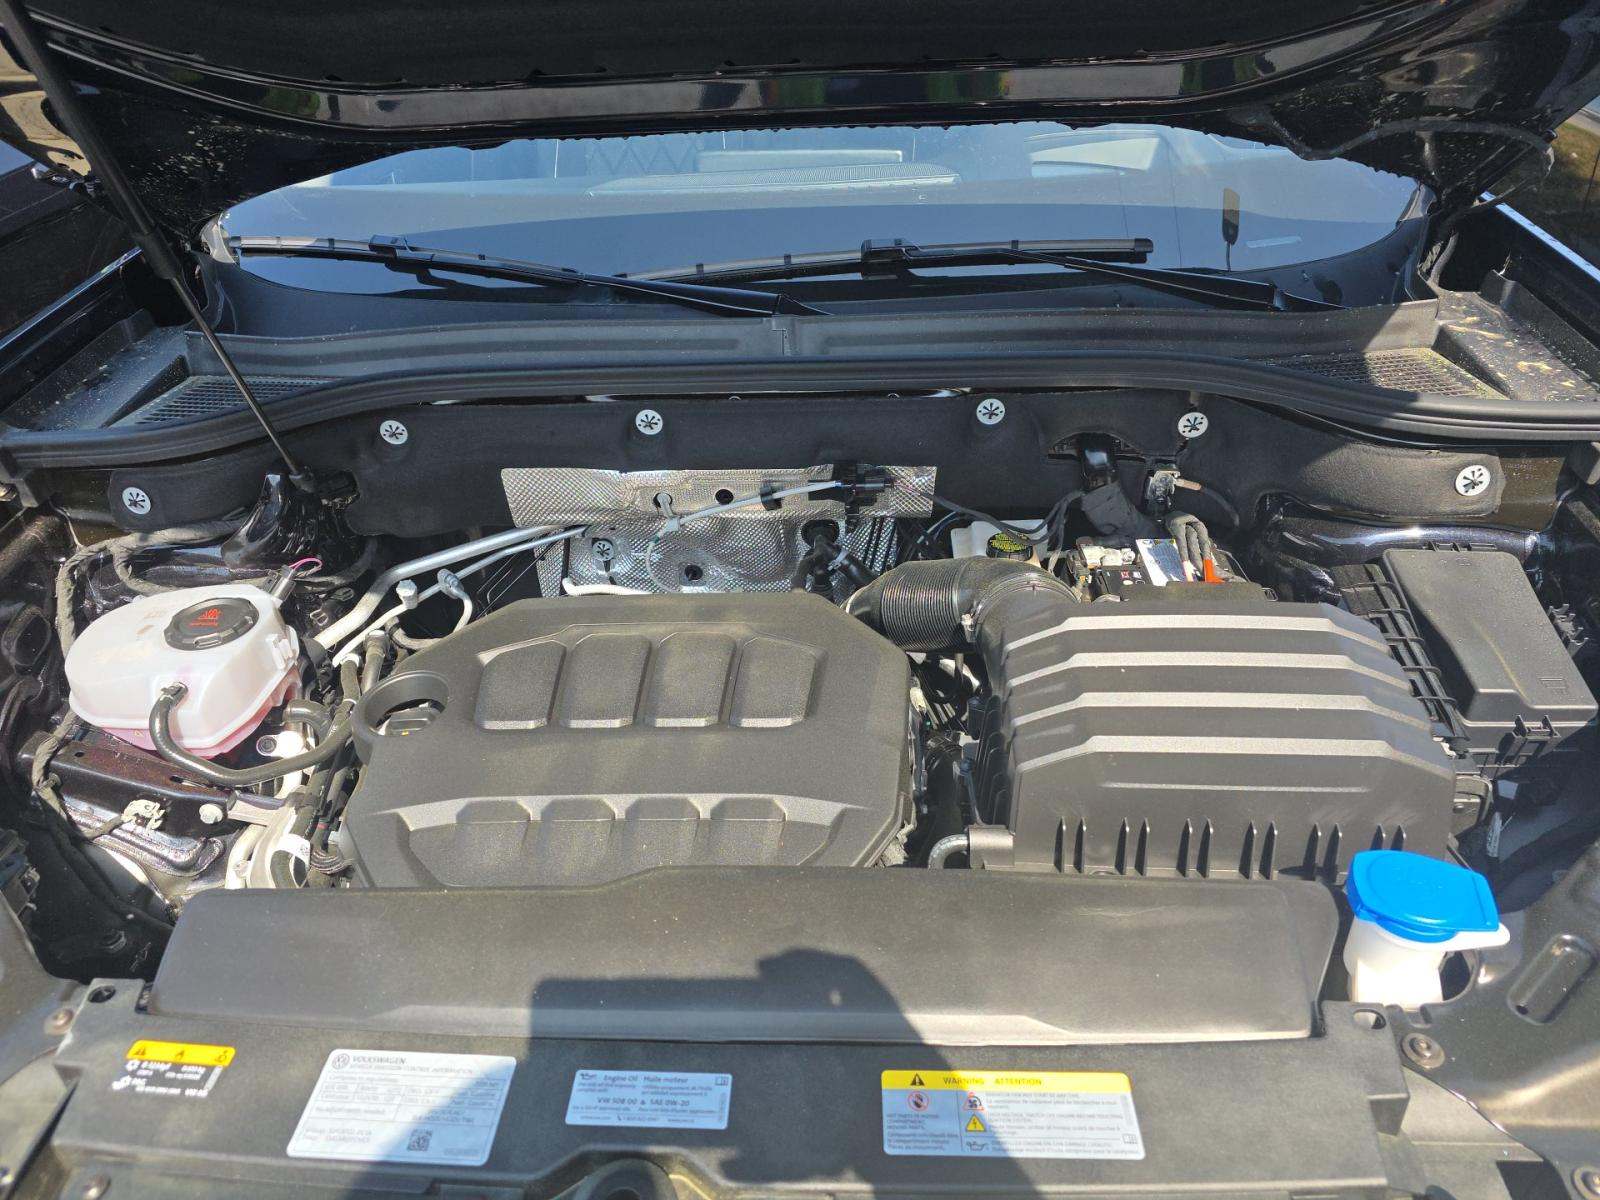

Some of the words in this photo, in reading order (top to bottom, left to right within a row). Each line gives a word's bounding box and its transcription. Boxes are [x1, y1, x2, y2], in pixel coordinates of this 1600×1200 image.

[352, 1055, 407, 1065] VOLKSWAGEN
[603, 1074, 626, 1084] Engine
[627, 1074, 638, 1082] Oil
[643, 1075, 662, 1083] Huile
[663, 1076, 688, 1084] moteur
[943, 1077, 984, 1086] WARNING
[994, 1078, 1042, 1086] ATTENTION
[597, 1096, 611, 1104] VW
[611, 1097, 626, 1105] 508
